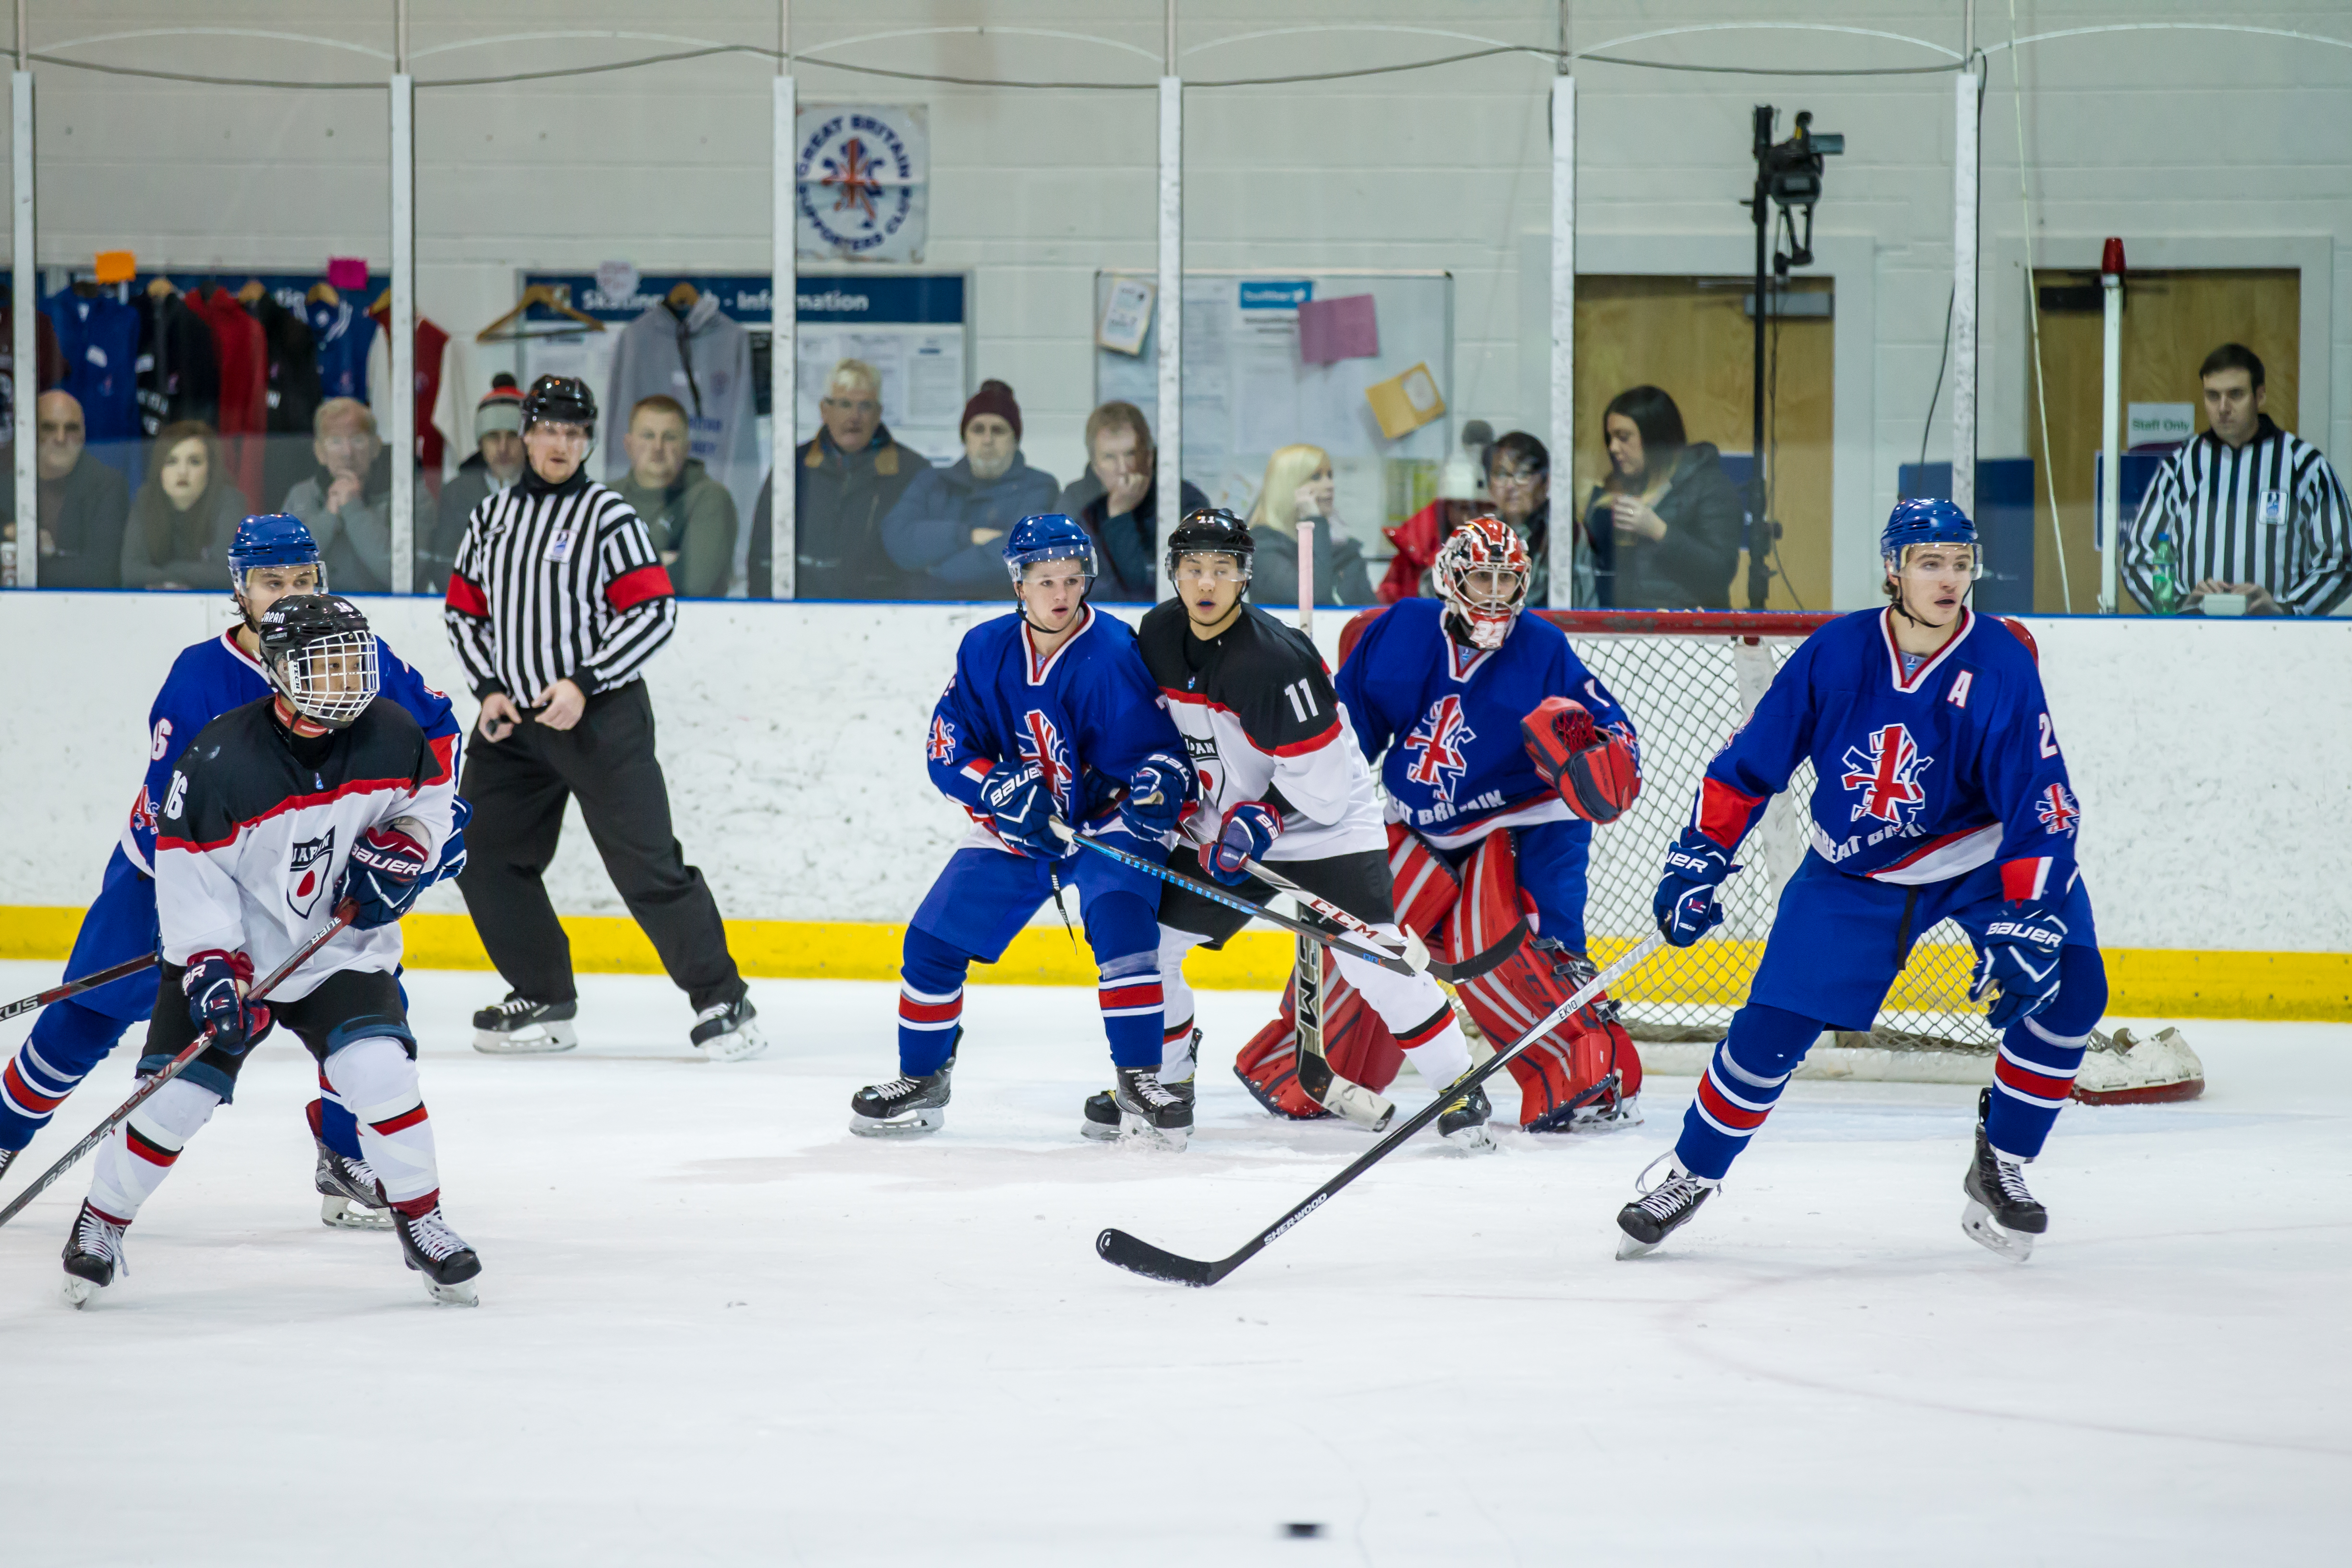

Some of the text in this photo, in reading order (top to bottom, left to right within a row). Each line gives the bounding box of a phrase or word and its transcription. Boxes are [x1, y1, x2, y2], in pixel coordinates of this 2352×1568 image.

[737, 289, 869, 311] Infmation
[2132, 418, 2190, 431] Staff Only
[1198, 515, 1215, 524] 11
[261, 612, 285, 624] JAPAN
[1285, 678, 1319, 723] 11
[1947, 669, 1973, 709] A
[164, 770, 188, 820] 16
[292, 834, 331, 863] JAPAN
[310, 916, 342, 945] AUER
[1310, 898, 1379, 940] CCM
[1985, 922, 2063, 948] BAUER
[1558, 999, 1578, 1020] EK10
[41, 1123, 113, 1192] BAUER
[1264, 1192, 1327, 1246] SHER-WOOD
